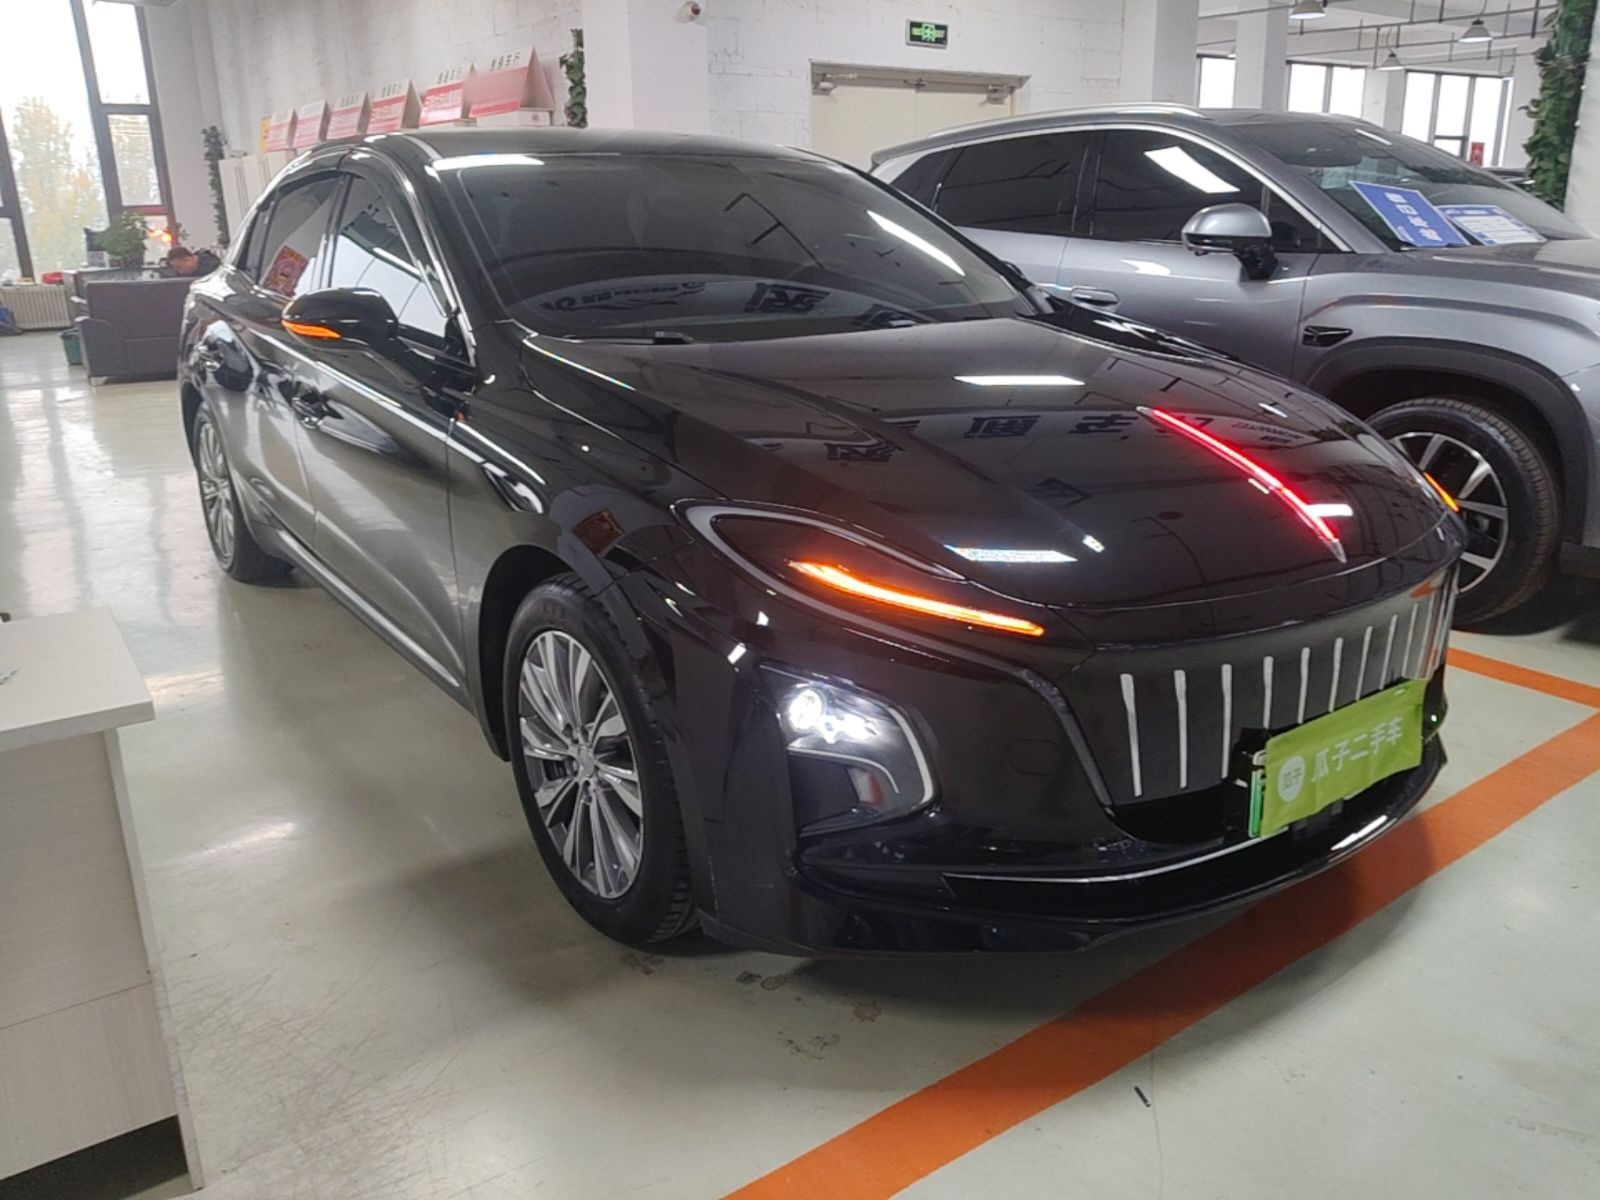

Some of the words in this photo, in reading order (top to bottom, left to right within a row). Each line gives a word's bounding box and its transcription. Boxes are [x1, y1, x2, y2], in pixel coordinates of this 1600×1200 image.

[1311, 717, 1404, 784] 瓜子二手车
